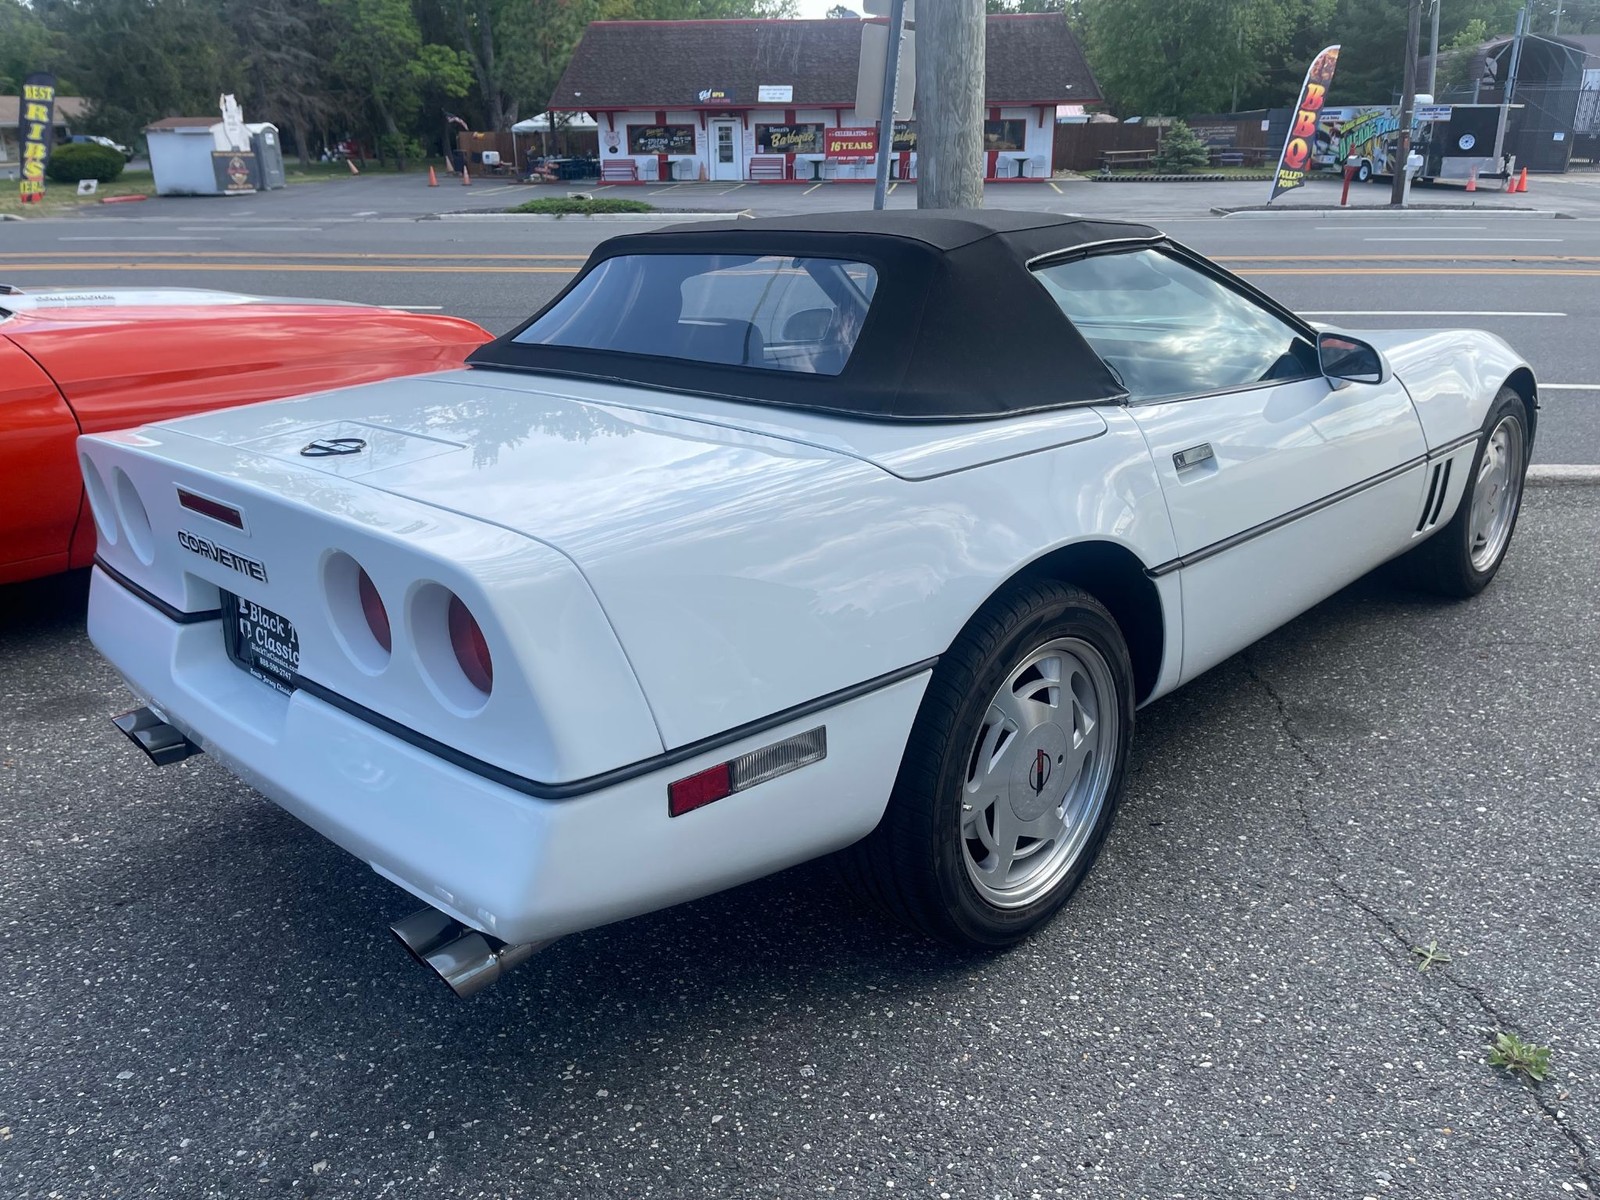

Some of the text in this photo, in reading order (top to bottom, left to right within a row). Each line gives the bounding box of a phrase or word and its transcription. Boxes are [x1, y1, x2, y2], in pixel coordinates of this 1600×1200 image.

[24, 85, 54, 101] BEST
[23, 103, 49, 178] RIBS
[771, 130, 815, 148] Barbeque
[1284, 83, 1325, 169] BBQ
[842, 142, 873, 150] YEARS
[177, 528, 268, 583] CORVETTE
[249, 602, 285, 637] Black
